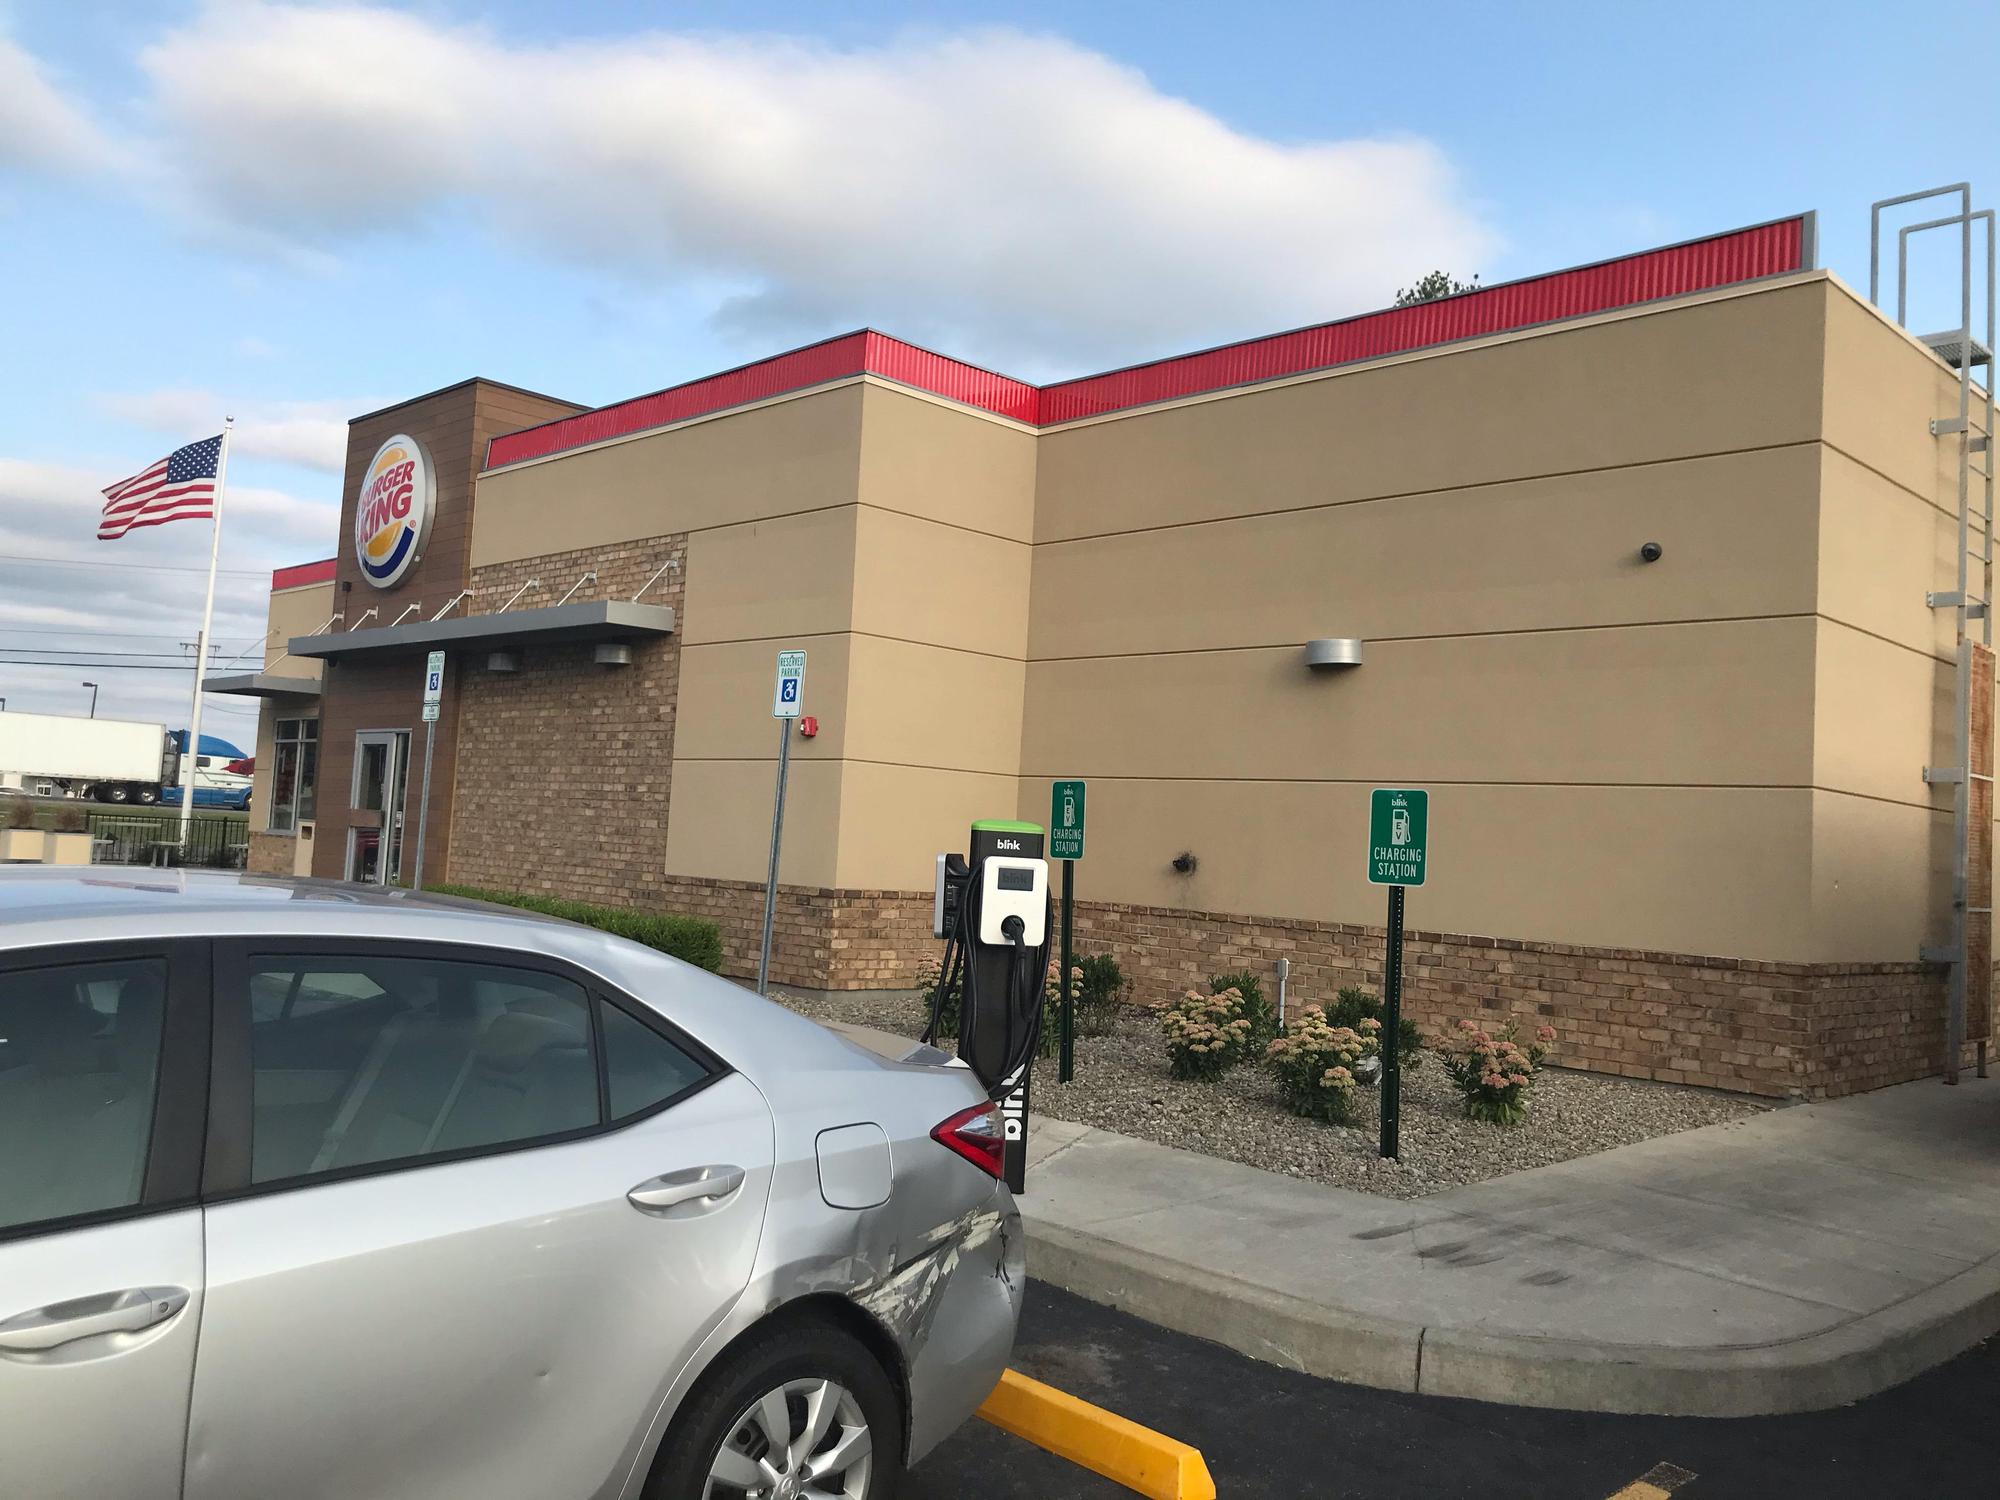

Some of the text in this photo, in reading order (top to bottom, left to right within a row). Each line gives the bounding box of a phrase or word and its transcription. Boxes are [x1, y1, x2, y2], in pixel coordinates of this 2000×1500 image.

[361, 461, 415, 508] BURGER
[360, 484, 413, 543] KING
[1053, 828, 1082, 840] CHARGING
[997, 838, 1021, 850] blink
[1055, 841, 1079, 852] STATION
[1374, 847, 1422, 862] CHARGING
[1377, 862, 1417, 877] STATION
